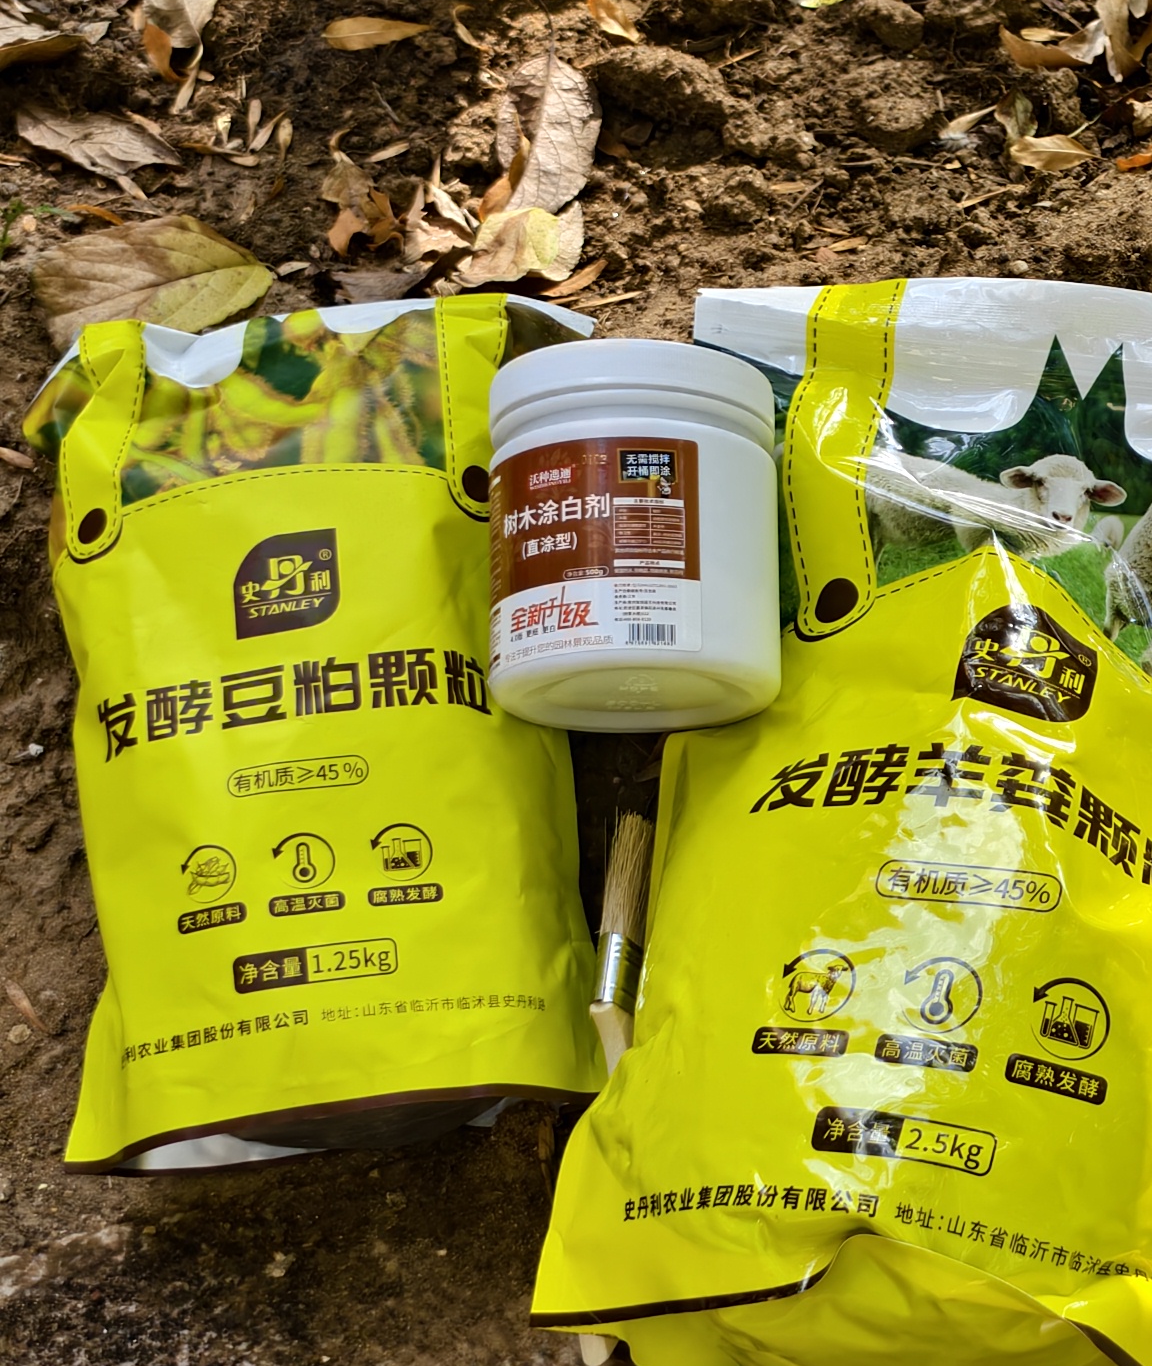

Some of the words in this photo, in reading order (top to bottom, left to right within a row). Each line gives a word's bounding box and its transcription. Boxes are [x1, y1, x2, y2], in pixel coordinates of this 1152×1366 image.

[626, 453, 671, 465] 无需搅拌
[627, 465, 672, 476] 开桶即涂
[503, 492, 611, 539] 树木涂白剂
[522, 531, 578, 560] (直涂型)
[241, 555, 331, 603] 史丹利
[248, 596, 325, 619] STANLEY
[510, 585, 600, 633] 全新升级
[972, 628, 1086, 695] 史丹利
[973, 666, 1072, 703] STANLEY
[97, 647, 493, 764] 发酵豆粕颗粒
[273, 893, 341, 914] 高温灭菌
[372, 885, 439, 904] 腐熟发酵
[181, 904, 242, 931] 天然原料
[239, 956, 303, 985] 净含量
[312, 947, 391, 974] 1.25kg
[757, 1031, 840, 1053] 天然原料
[881, 1038, 969, 1067] 高温灭菌
[1011, 1059, 1101, 1099] 腐熟发酵
[823, 1117, 891, 1145] 净含量
[905, 1126, 984, 1170] 2.5kg
[623, 1184, 880, 1222] 史丹利农业集团股份有限公司
